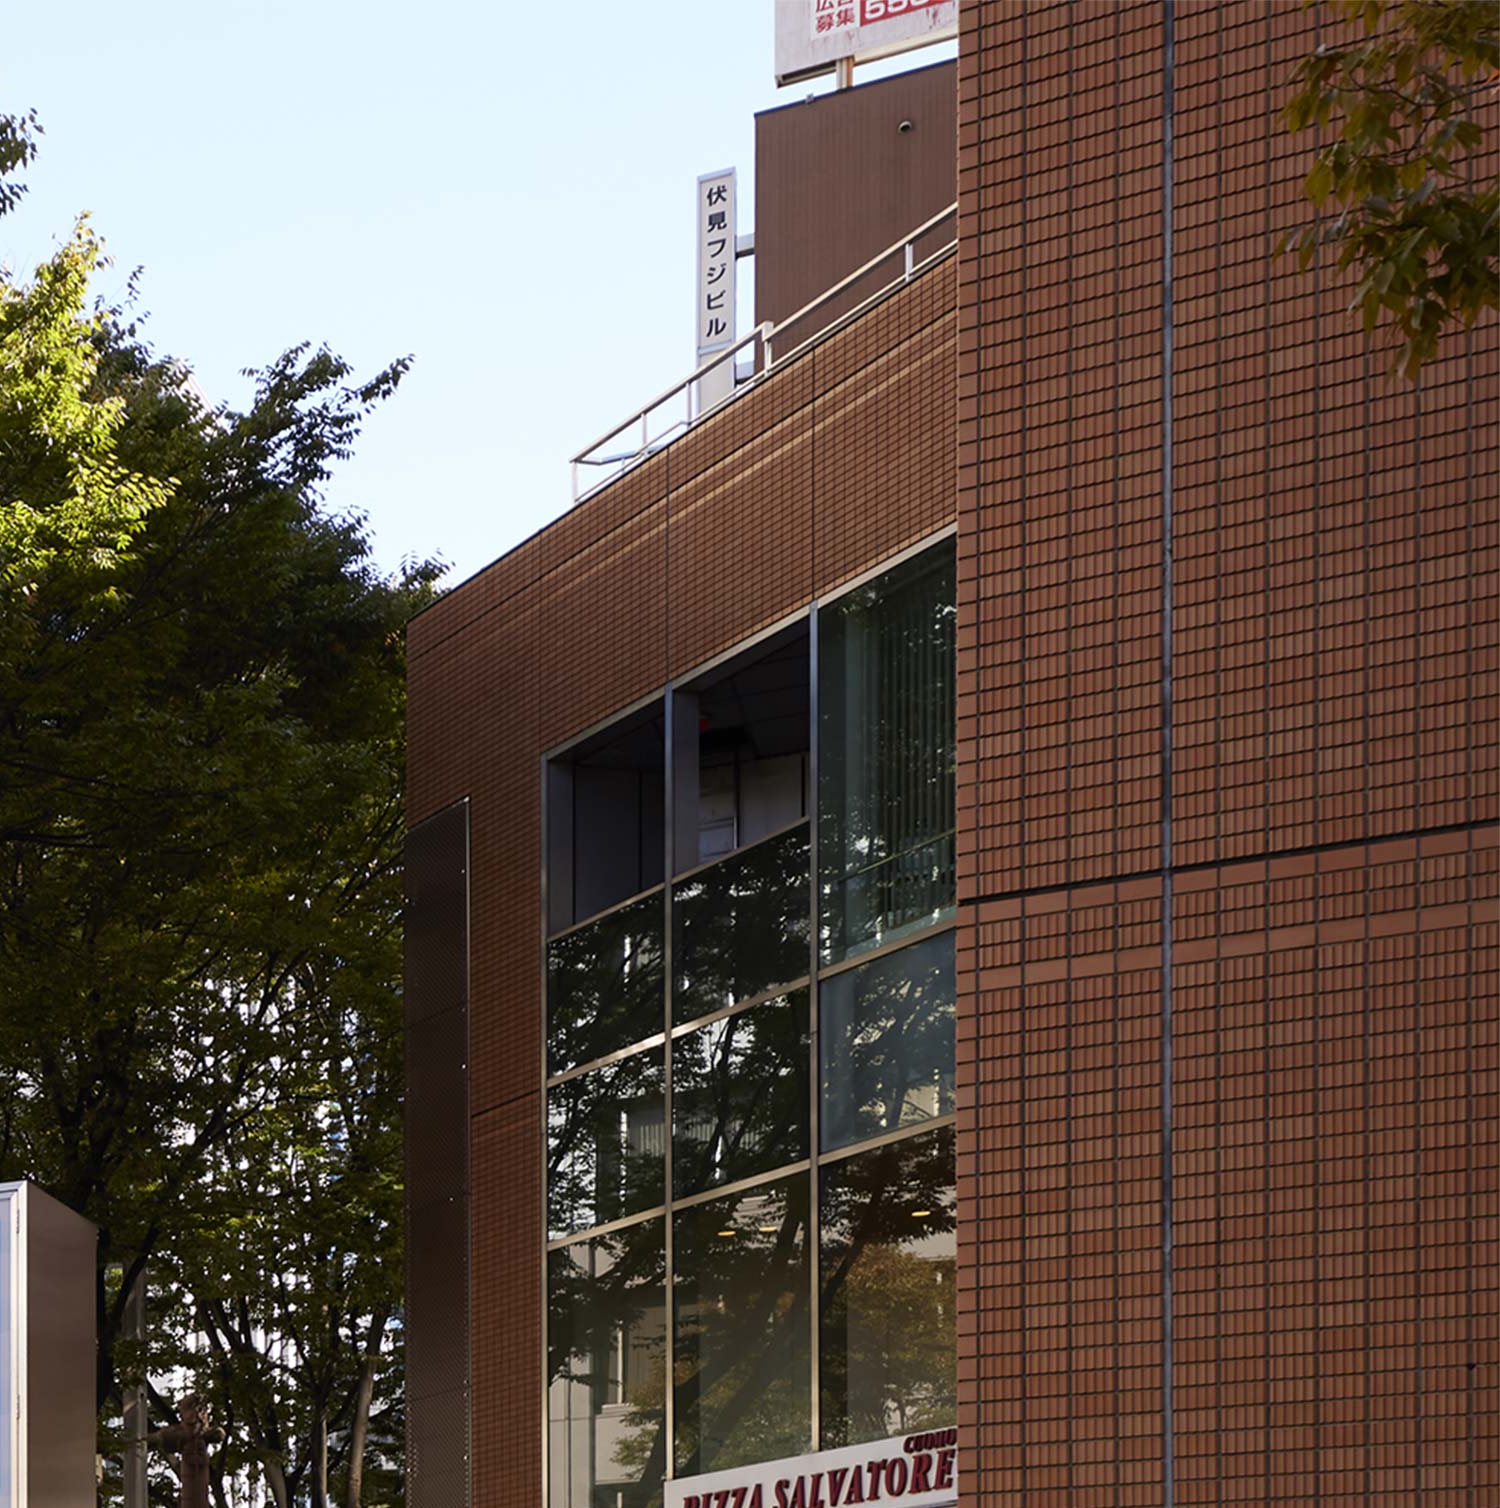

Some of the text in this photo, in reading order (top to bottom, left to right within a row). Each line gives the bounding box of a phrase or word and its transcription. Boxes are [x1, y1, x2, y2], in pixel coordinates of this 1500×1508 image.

[815, 8, 855, 33] 募集
[706, 185, 727, 338] 伏見フジビル
